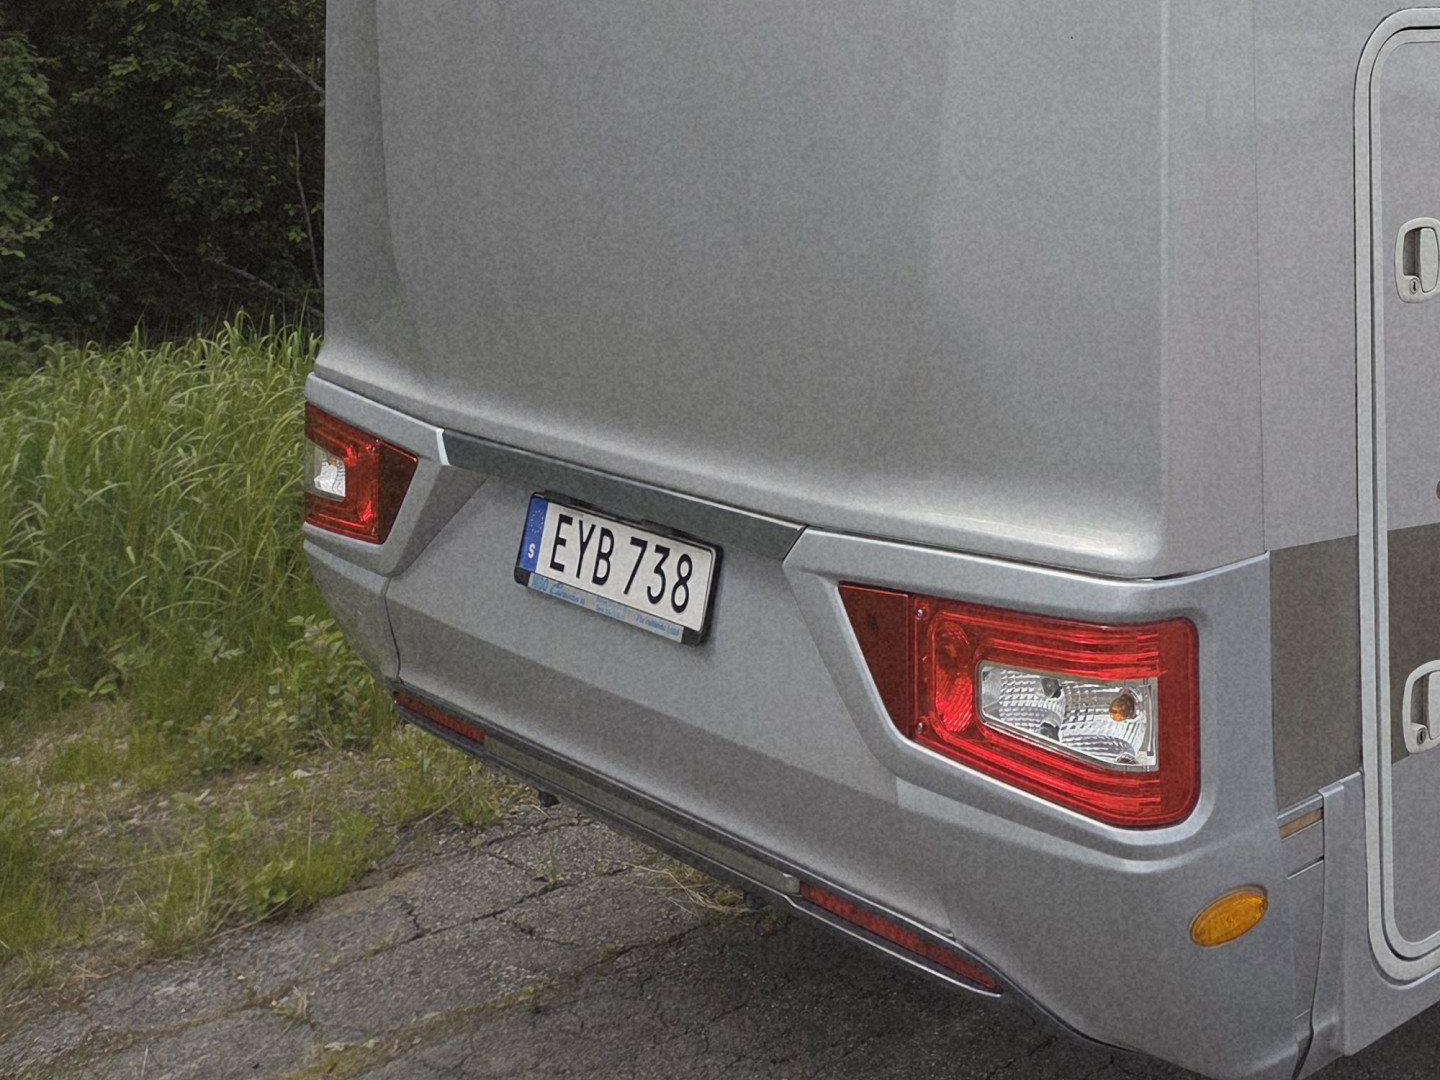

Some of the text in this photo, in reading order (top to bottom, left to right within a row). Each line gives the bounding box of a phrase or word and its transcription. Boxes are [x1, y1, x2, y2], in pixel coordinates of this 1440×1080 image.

[527, 513, 694, 614] S EYB 738
